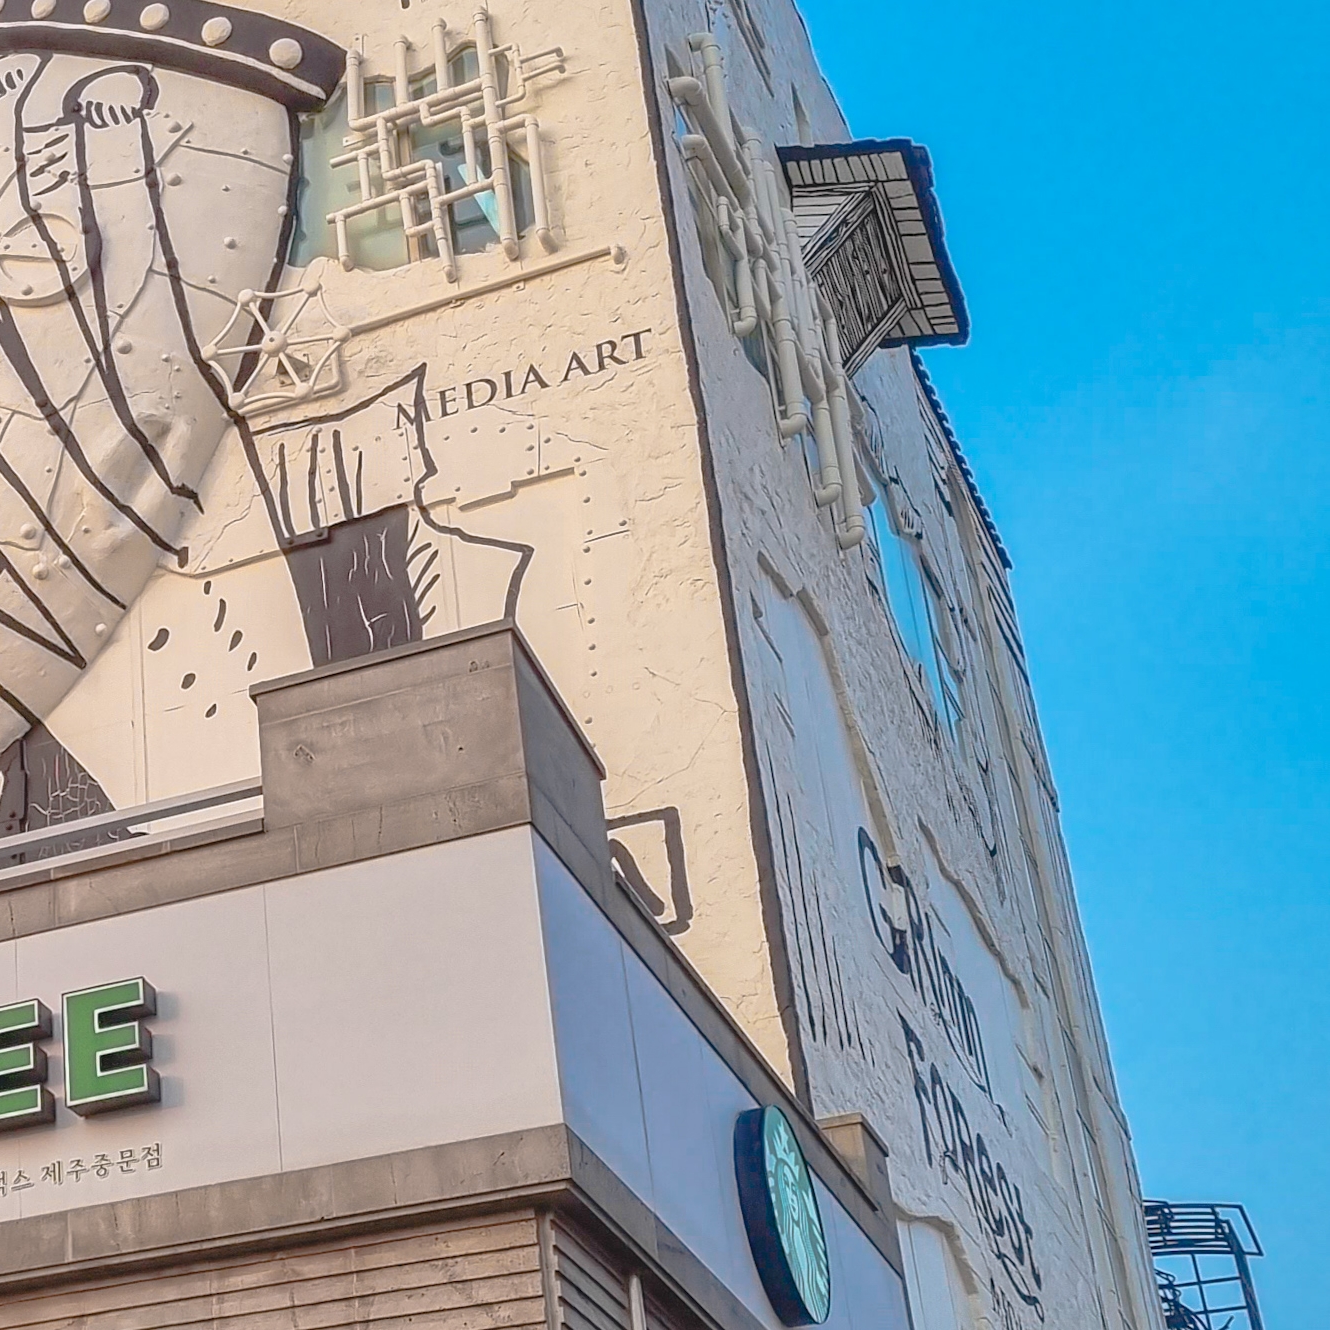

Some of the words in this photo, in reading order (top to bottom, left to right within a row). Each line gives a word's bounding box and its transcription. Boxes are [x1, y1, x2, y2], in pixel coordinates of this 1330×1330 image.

[392, 363, 551, 430] MEDIA
[557, 328, 652, 387] ART
[41, 1142, 163, 1186] 제주중문점
